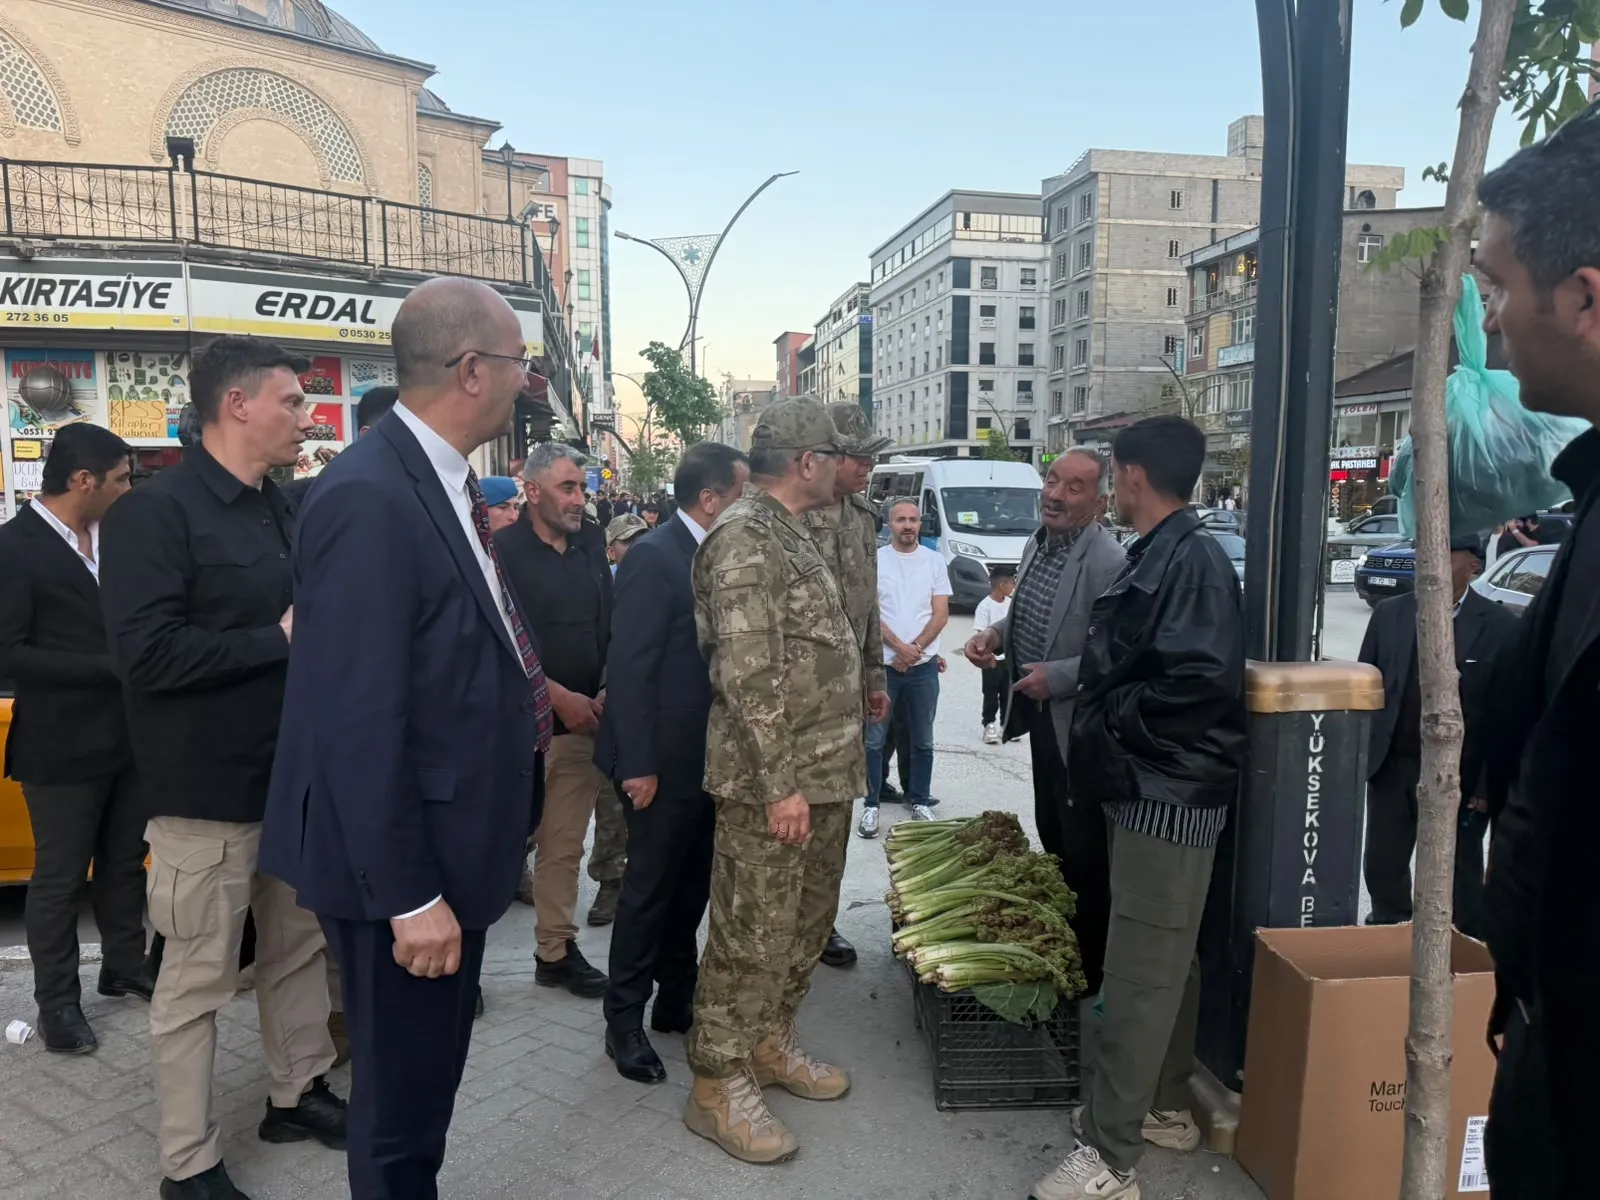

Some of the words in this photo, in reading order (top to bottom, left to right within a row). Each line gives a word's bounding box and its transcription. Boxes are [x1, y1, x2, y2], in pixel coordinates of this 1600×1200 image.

[0, 273, 172, 310] KIRTASİYE
[6, 312, 30, 322] 272
[34, 312, 49, 322] 36
[53, 313, 69, 323] 05
[255, 290, 377, 325] ERDAL
[350, 329, 376, 339] 0530
[110, 400, 164, 421] KPSS
